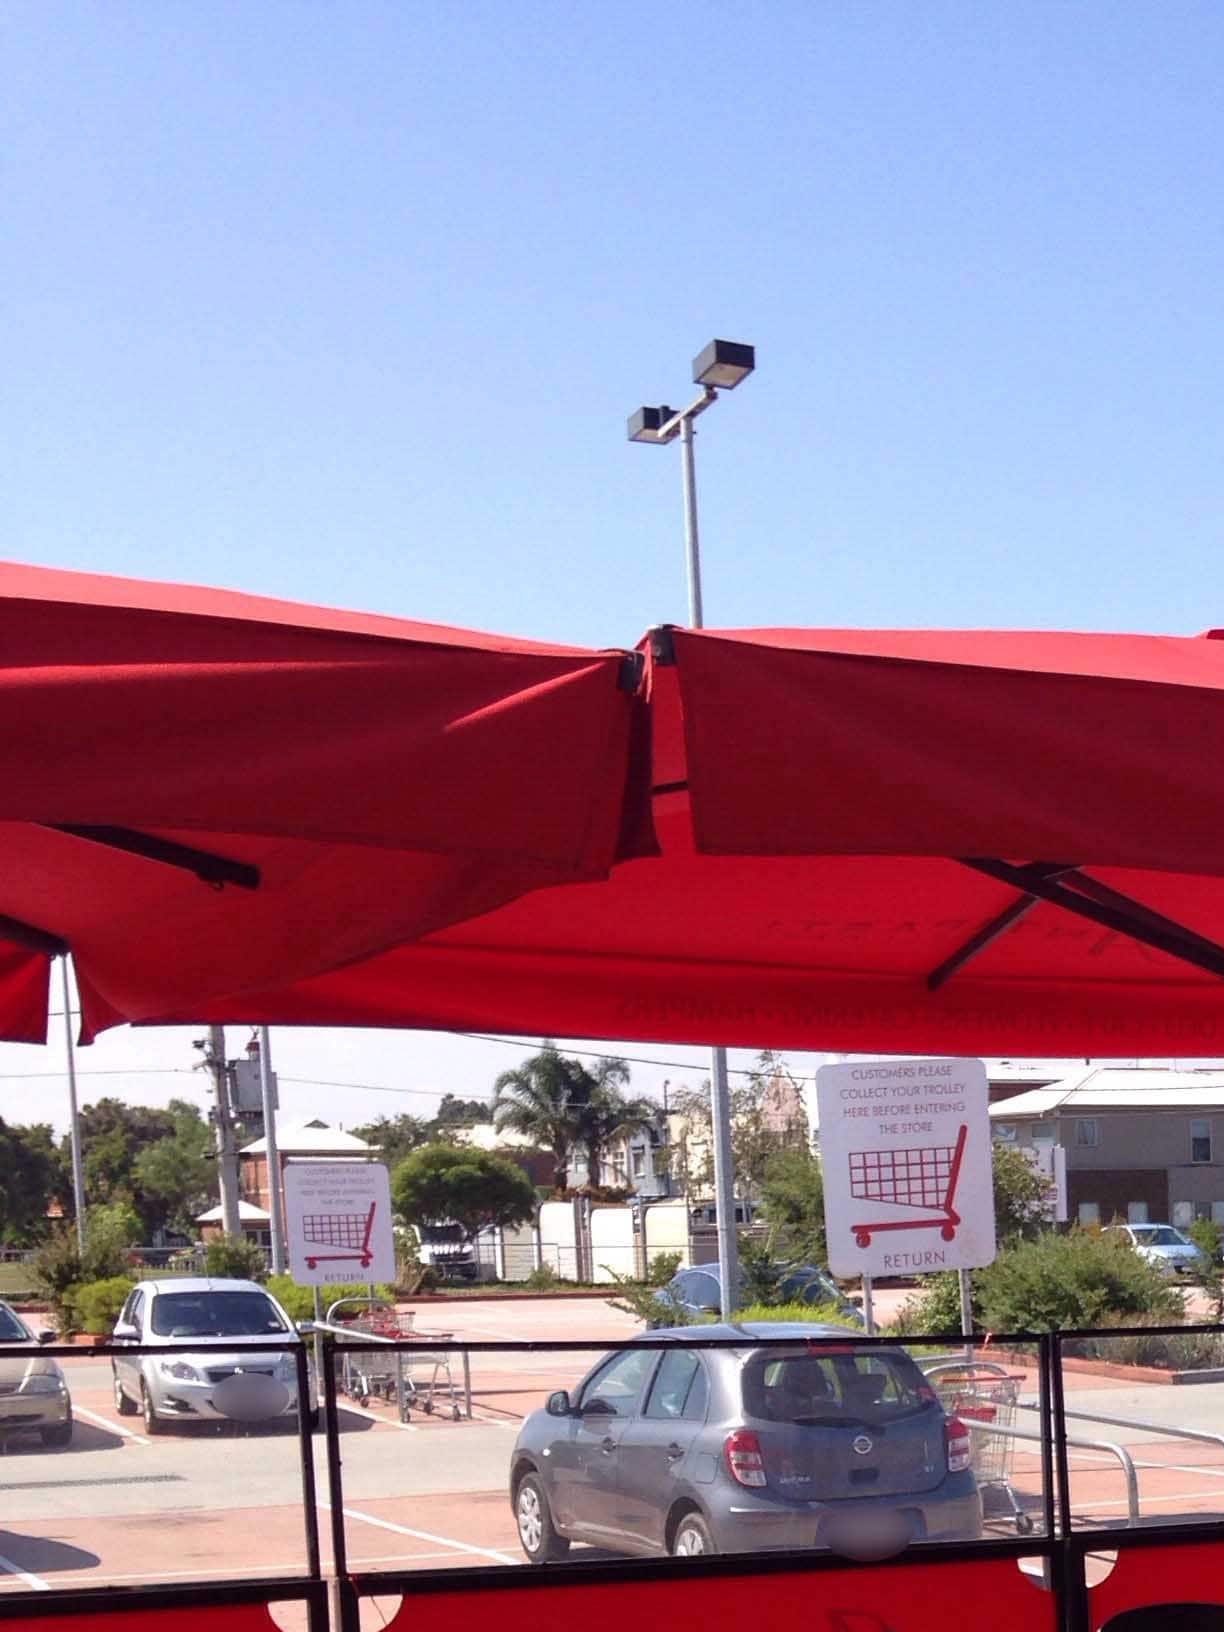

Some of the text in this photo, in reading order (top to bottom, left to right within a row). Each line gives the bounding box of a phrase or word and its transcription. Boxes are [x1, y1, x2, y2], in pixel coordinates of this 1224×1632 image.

[851, 1065, 953, 1080] CUSTOMERS PLEASE
[840, 1083, 967, 1100] COLLECT YOUR TROLLEY
[843, 1102, 966, 1118] HERE BEFORE ENTERING
[879, 1121, 934, 1134] THE STORE
[884, 1251, 945, 1269] RETURN
